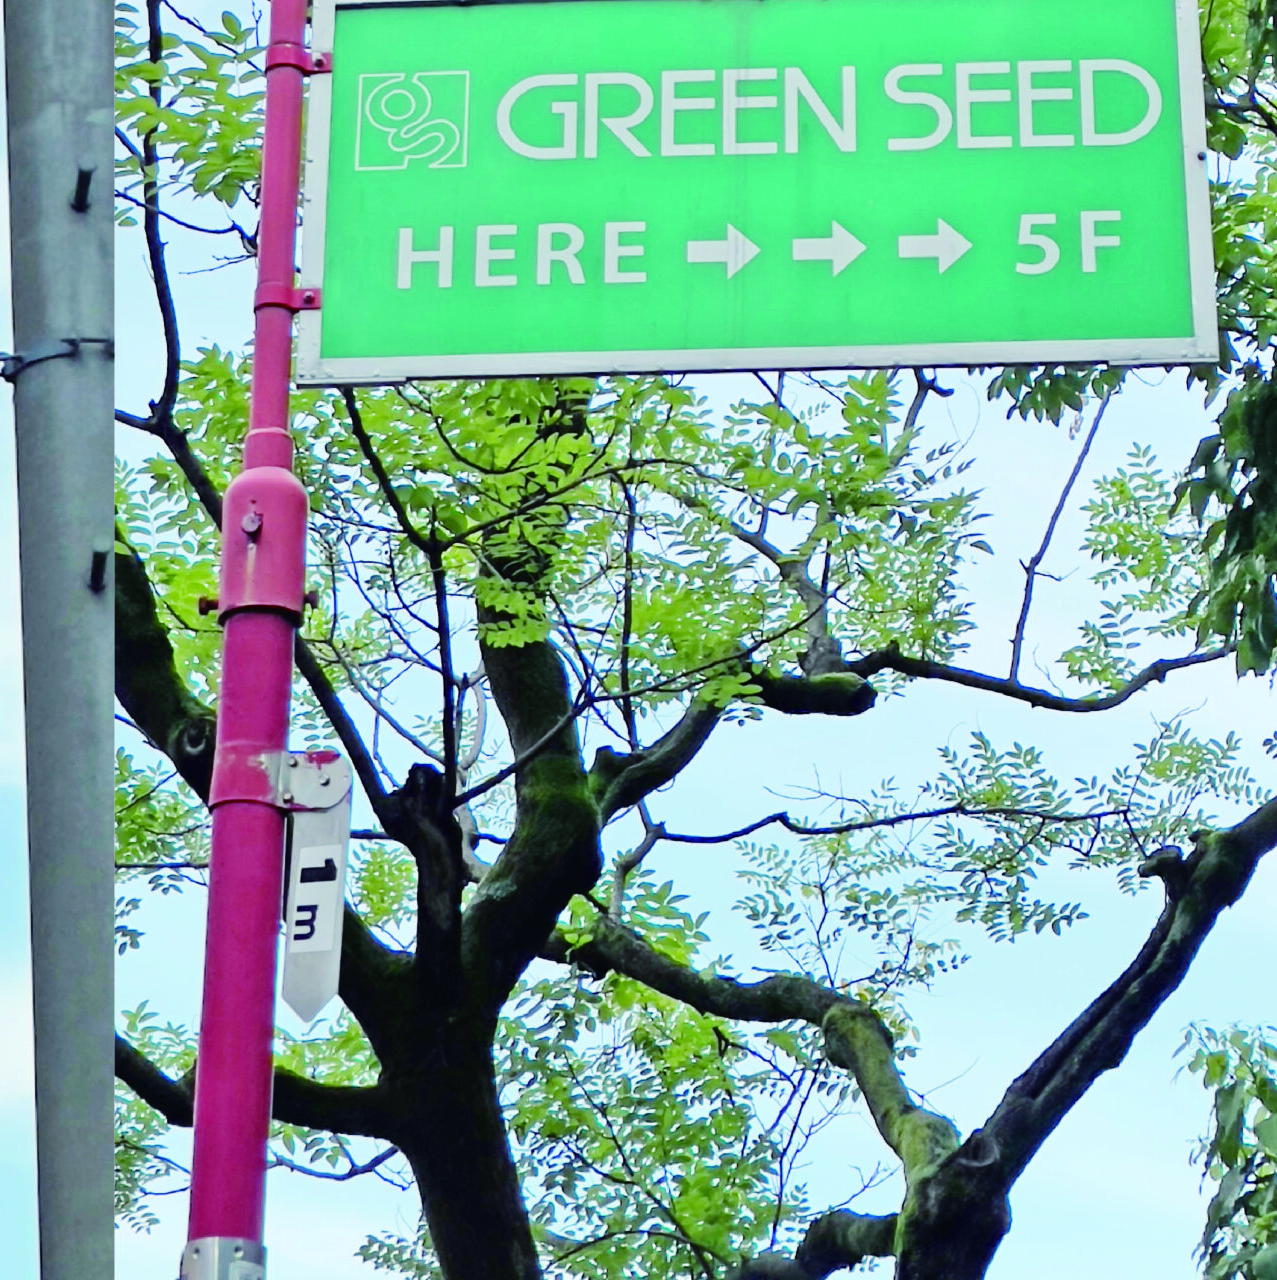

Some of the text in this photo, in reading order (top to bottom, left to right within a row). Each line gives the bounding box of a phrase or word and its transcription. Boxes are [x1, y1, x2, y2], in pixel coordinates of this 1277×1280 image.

[496, 66, 858, 160] GREEN
[884, 58, 1163, 152] SEED
[396, 221, 648, 289] HERE
